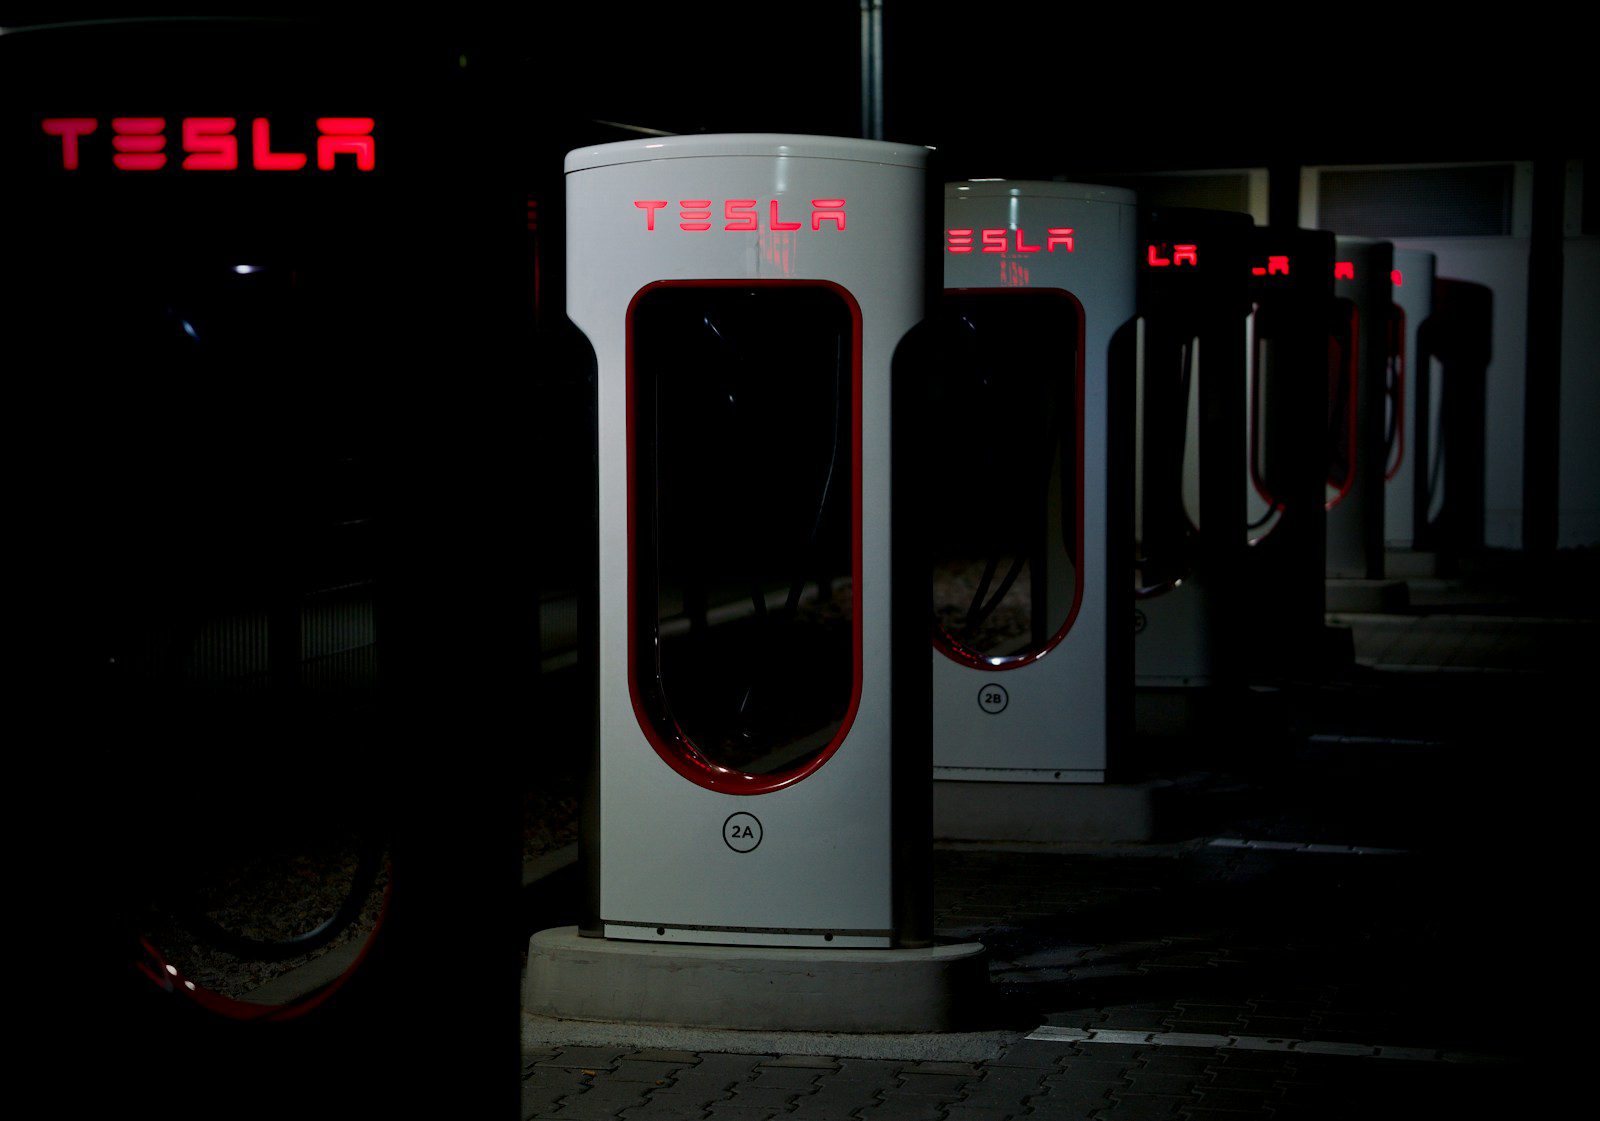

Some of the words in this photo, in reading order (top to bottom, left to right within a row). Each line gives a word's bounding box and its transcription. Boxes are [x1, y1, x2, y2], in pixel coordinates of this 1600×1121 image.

[41, 116, 377, 172] TESLA
[634, 199, 847, 232] TESLA
[985, 693, 1002, 704] 2B
[731, 825, 754, 839] 2A
